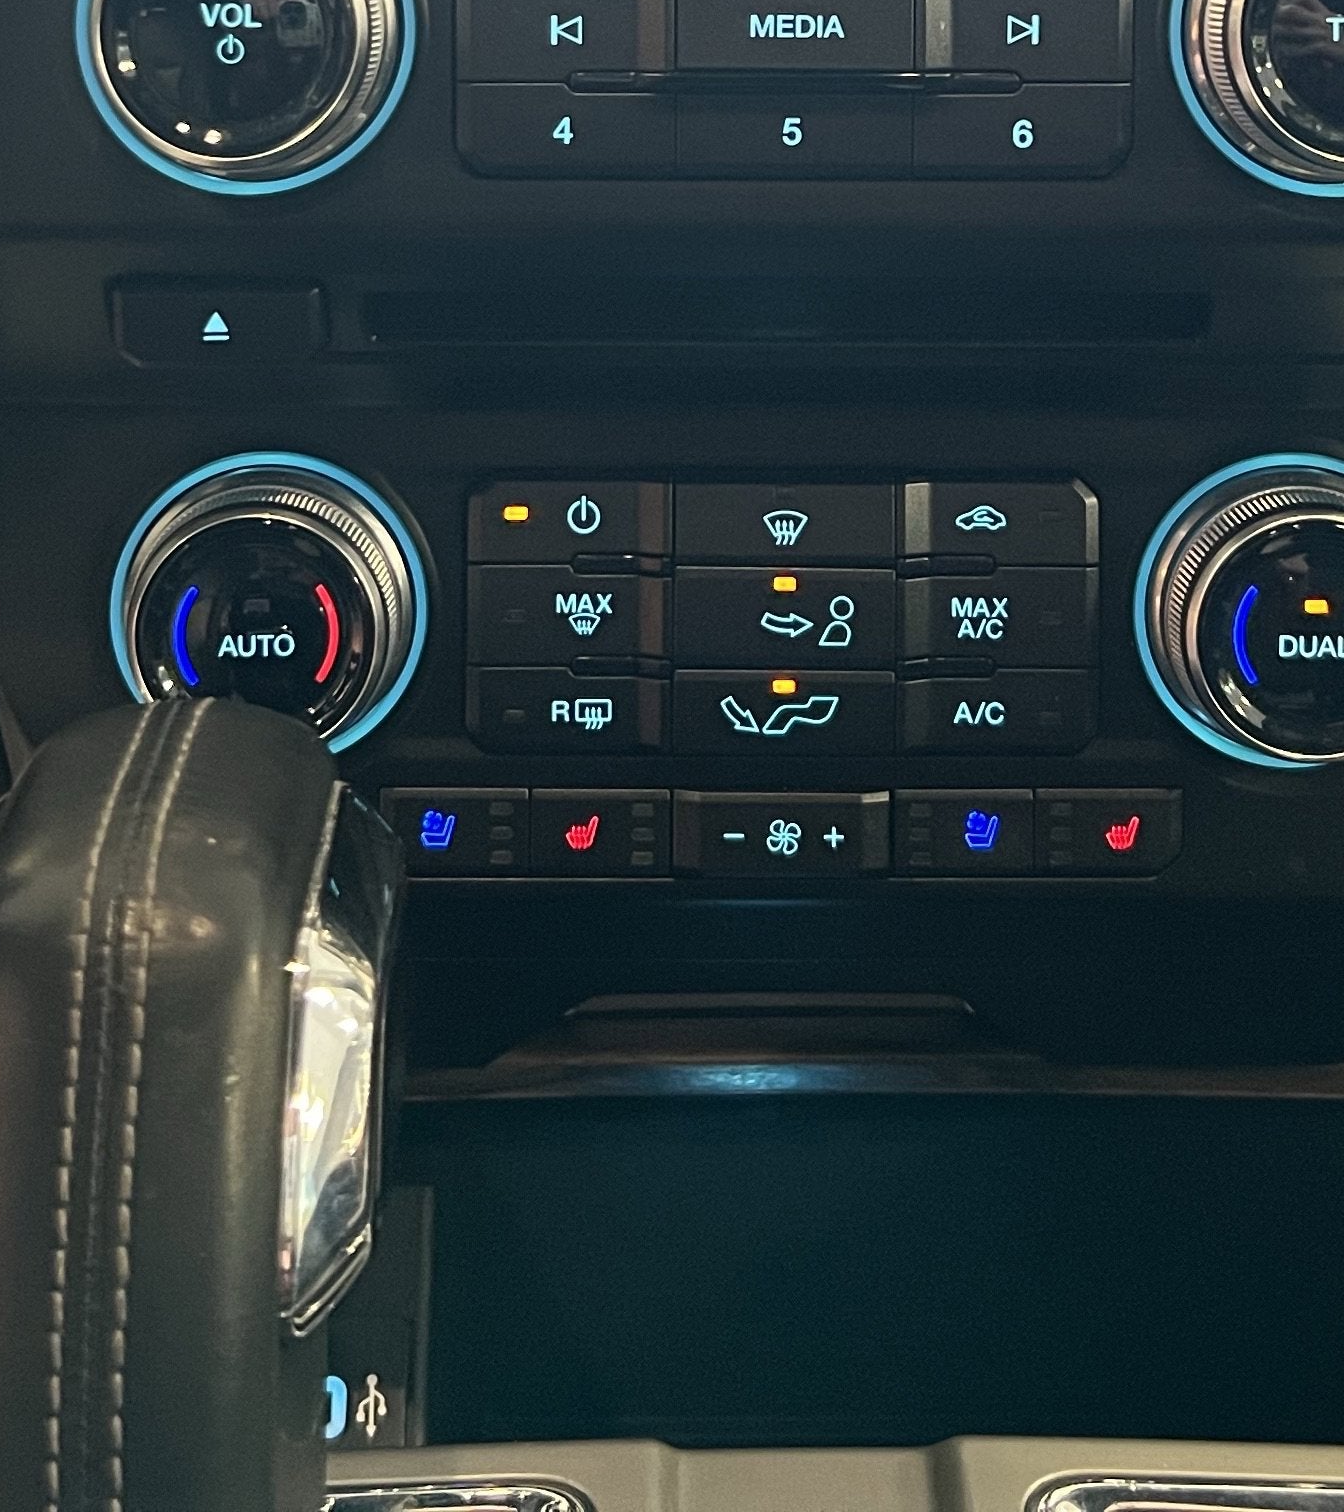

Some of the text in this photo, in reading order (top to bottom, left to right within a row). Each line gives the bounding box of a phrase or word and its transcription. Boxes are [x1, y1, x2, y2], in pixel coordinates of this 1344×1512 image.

[200, 2, 263, 28] VOL
[749, 14, 845, 39] MEDIA
[552, 116, 574, 145] 4
[782, 117, 803, 146] 5
[1012, 119, 1034, 149] 6
[555, 592, 613, 614] MAX
[951, 596, 1009, 619] MAX
[957, 618, 1004, 640] A/C
[218, 633, 295, 658] AUTO
[551, 700, 570, 723] R
[953, 701, 1005, 726] A/C
